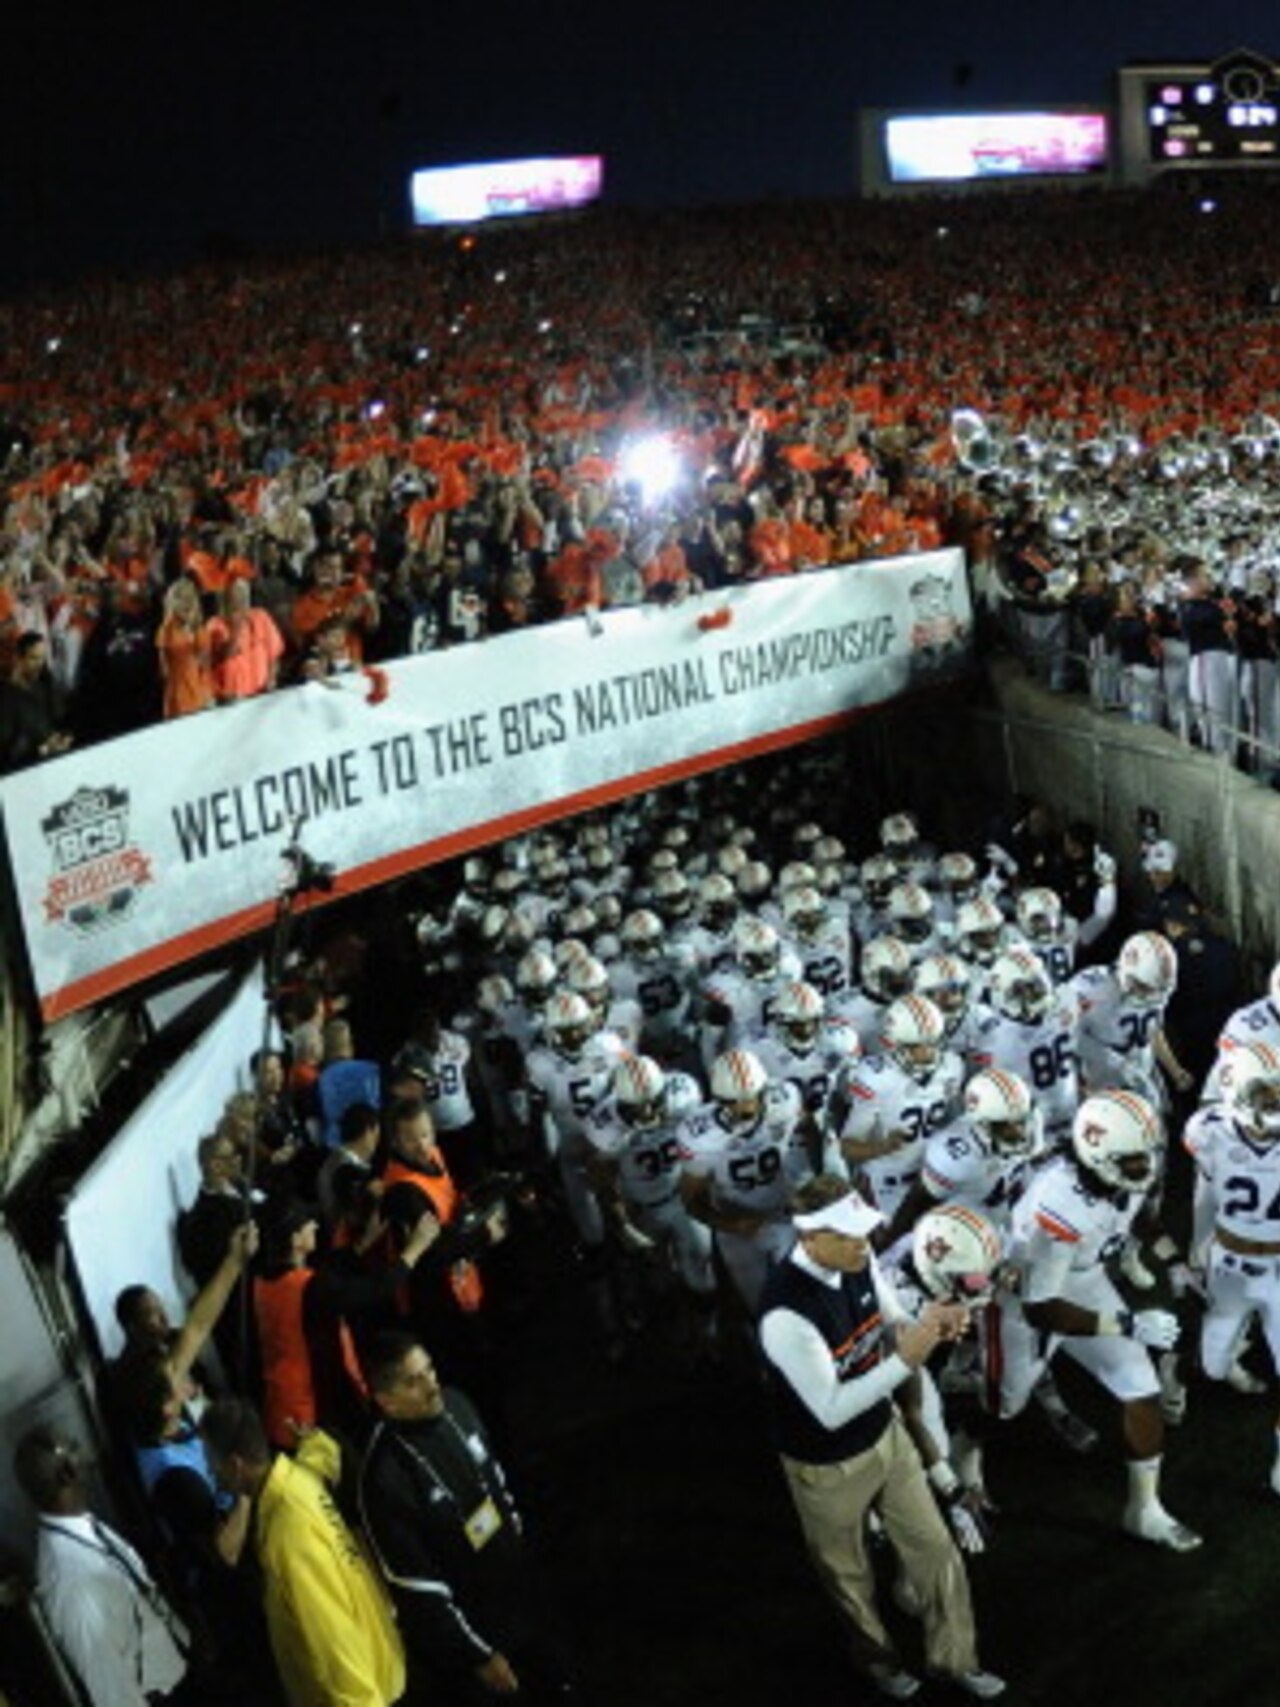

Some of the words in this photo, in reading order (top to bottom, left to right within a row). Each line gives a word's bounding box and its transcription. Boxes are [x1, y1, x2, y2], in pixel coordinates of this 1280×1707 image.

[171, 750, 363, 863] WELCOME
[370, 733, 419, 795] TO
[425, 713, 491, 777] THE
[500, 692, 566, 757] BCS
[573, 655, 715, 736] NATIONAL
[57, 814, 124, 869] BCS
